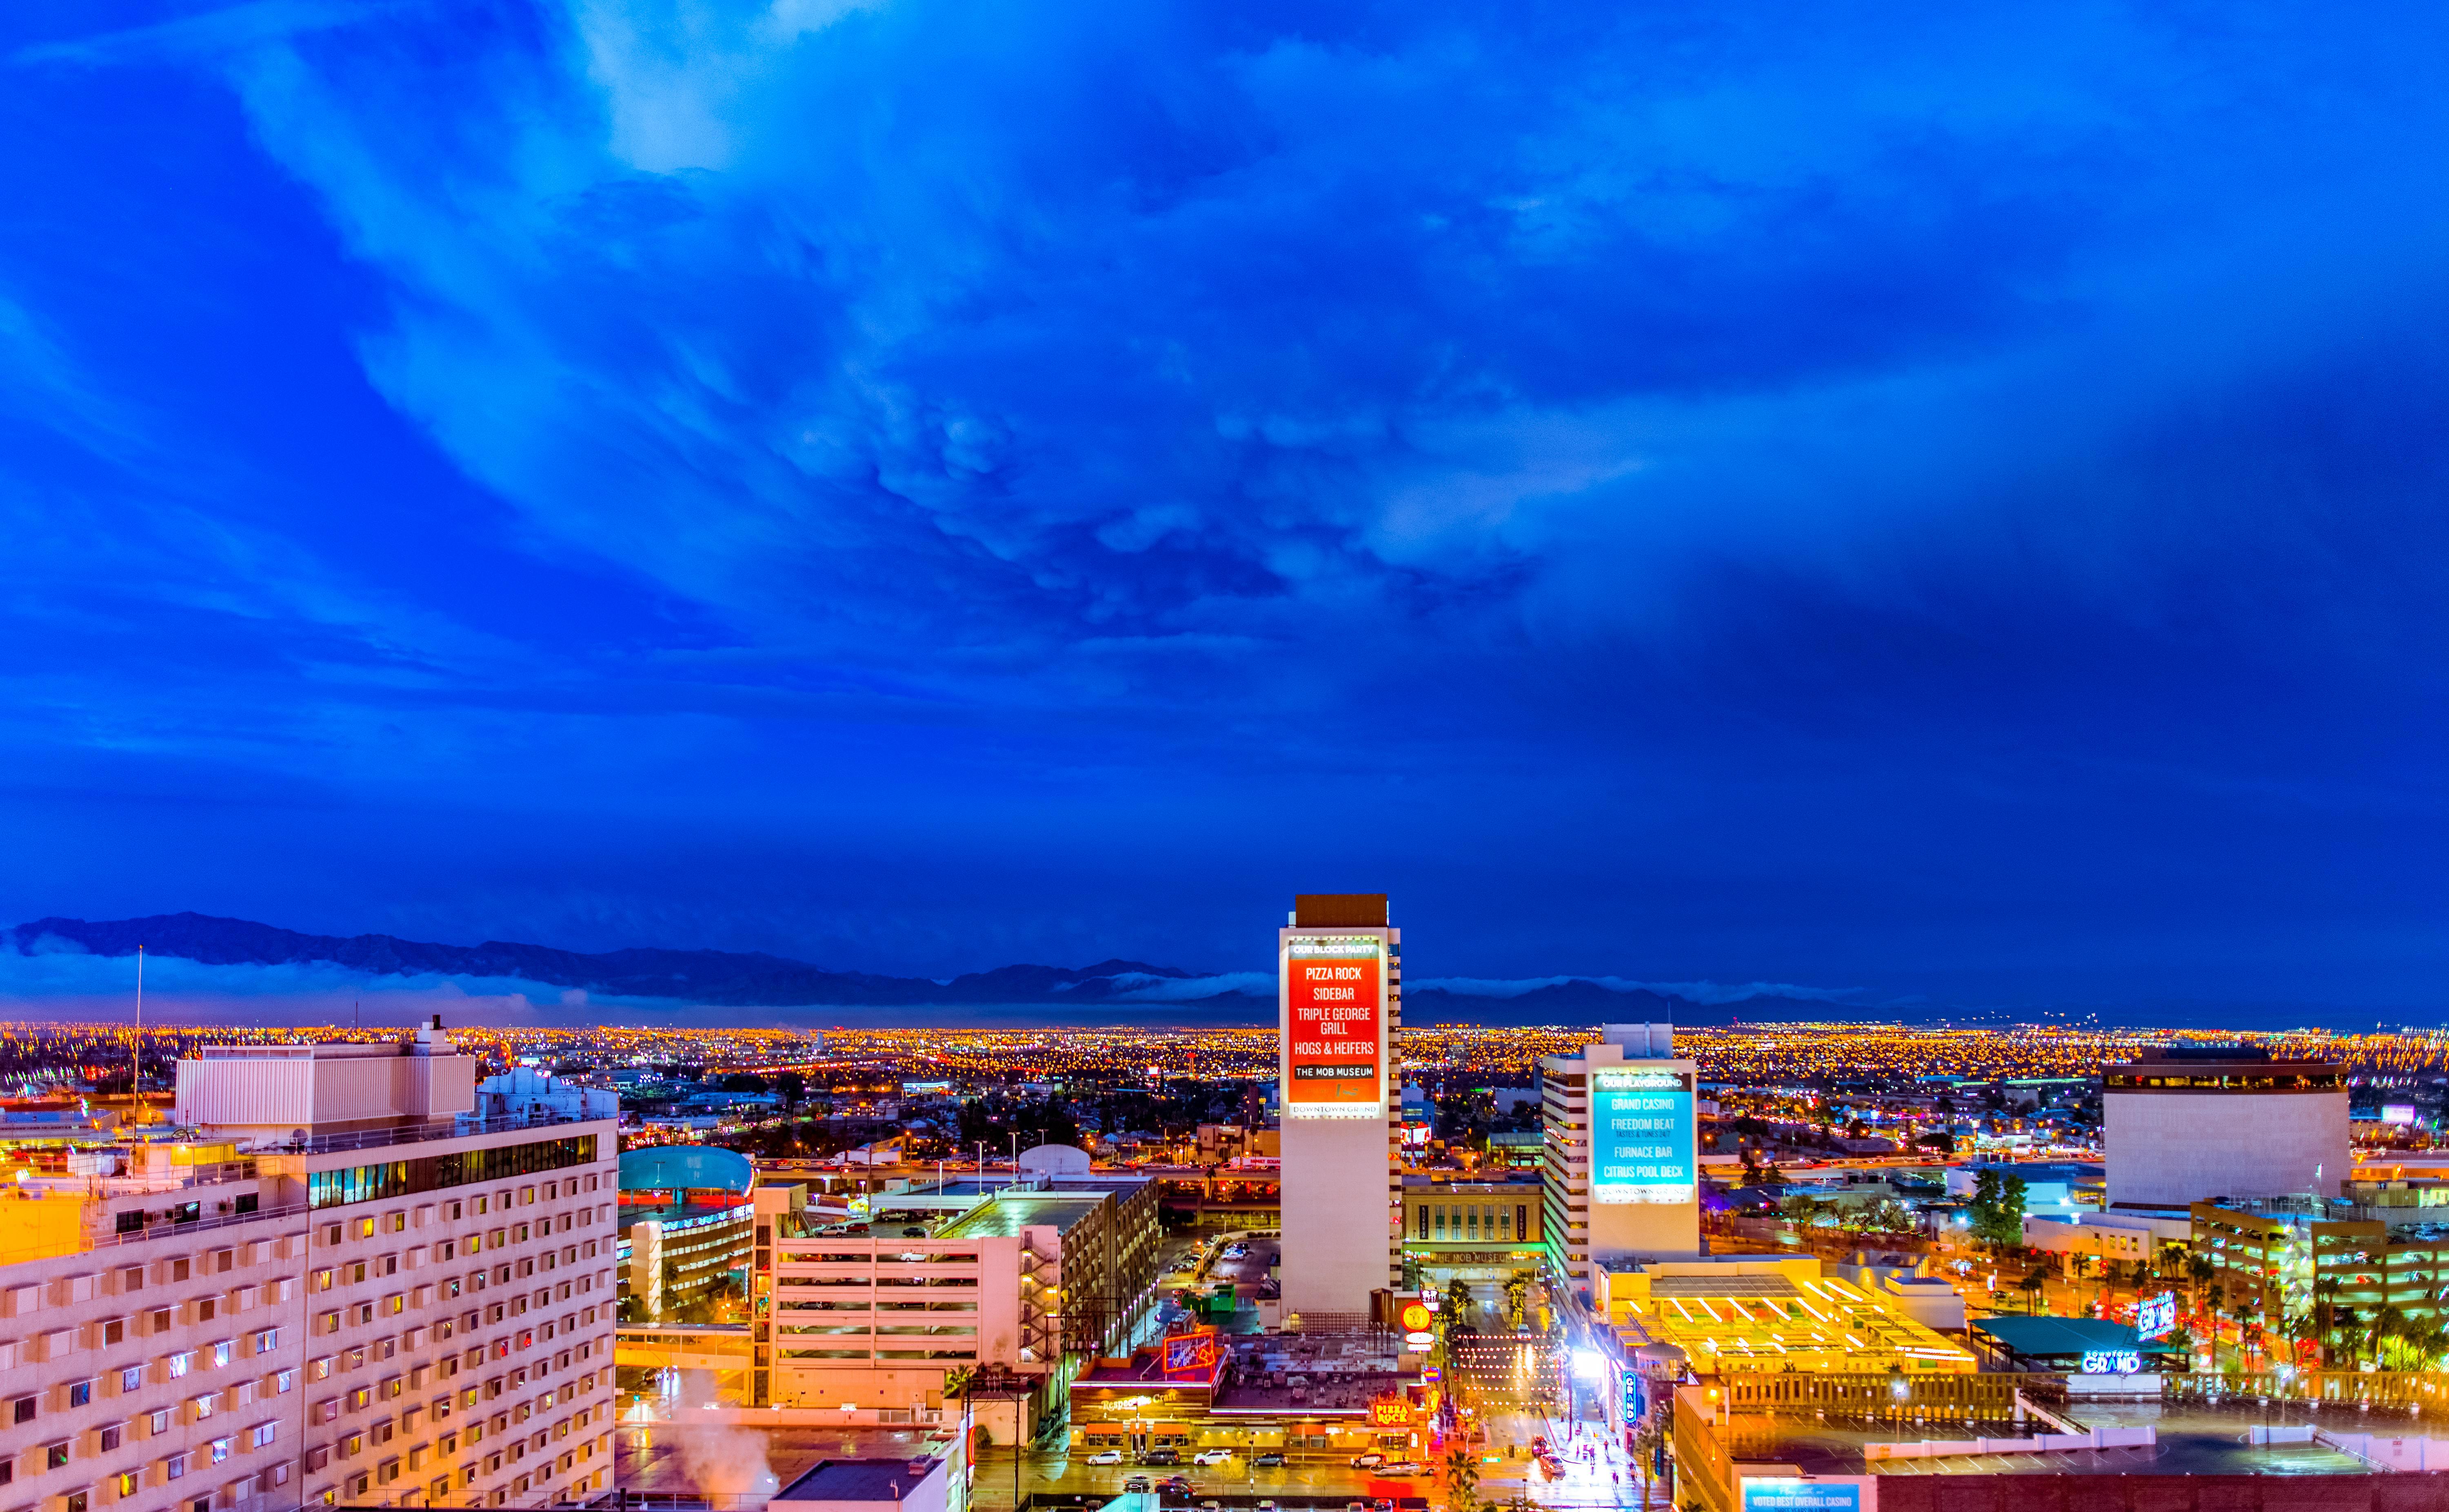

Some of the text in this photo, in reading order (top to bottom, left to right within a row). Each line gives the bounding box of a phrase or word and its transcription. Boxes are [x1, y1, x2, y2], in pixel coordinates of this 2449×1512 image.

[1293, 945, 1374, 954] OUR BLOCK PARTY
[1306, 967, 1362, 980] PIZZA ROCK
[1313, 987, 1354, 1000] SIDEBAR
[1298, 1008, 1370, 1020] TRIPLE GEORGE
[1321, 1022, 1348, 1035] GRILL
[1295, 1042, 1374, 1055] HOGS & HEIFERS
[1296, 1067, 1373, 1076] THE MOB MUSEUM
[1603, 1079, 1683, 1087] OUR PLAYGROUND
[1612, 1098, 1674, 1110] GRAND CASINO
[1612, 1118, 1674, 1130] FREEDOM BEAT
[1614, 1146, 1673, 1158] FURNACE BAR
[1604, 1166, 1683, 1177] CITRUS POOL DECK
[1431, 1253, 1512, 1262] THE MOB MUSEUM
[2138, 1301, 2176, 1332] GRAND
[2083, 1357, 2141, 1373] GRAND
[1152, 1391, 1176, 1404] Craft
[1626, 1377, 1634, 1419] GRAND
[1376, 1405, 1409, 1414] PIZZA
[1377, 1413, 1408, 1425] ROCK
[1753, 1496, 1852, 1507] VOTED BEST OVERALL CASINO
